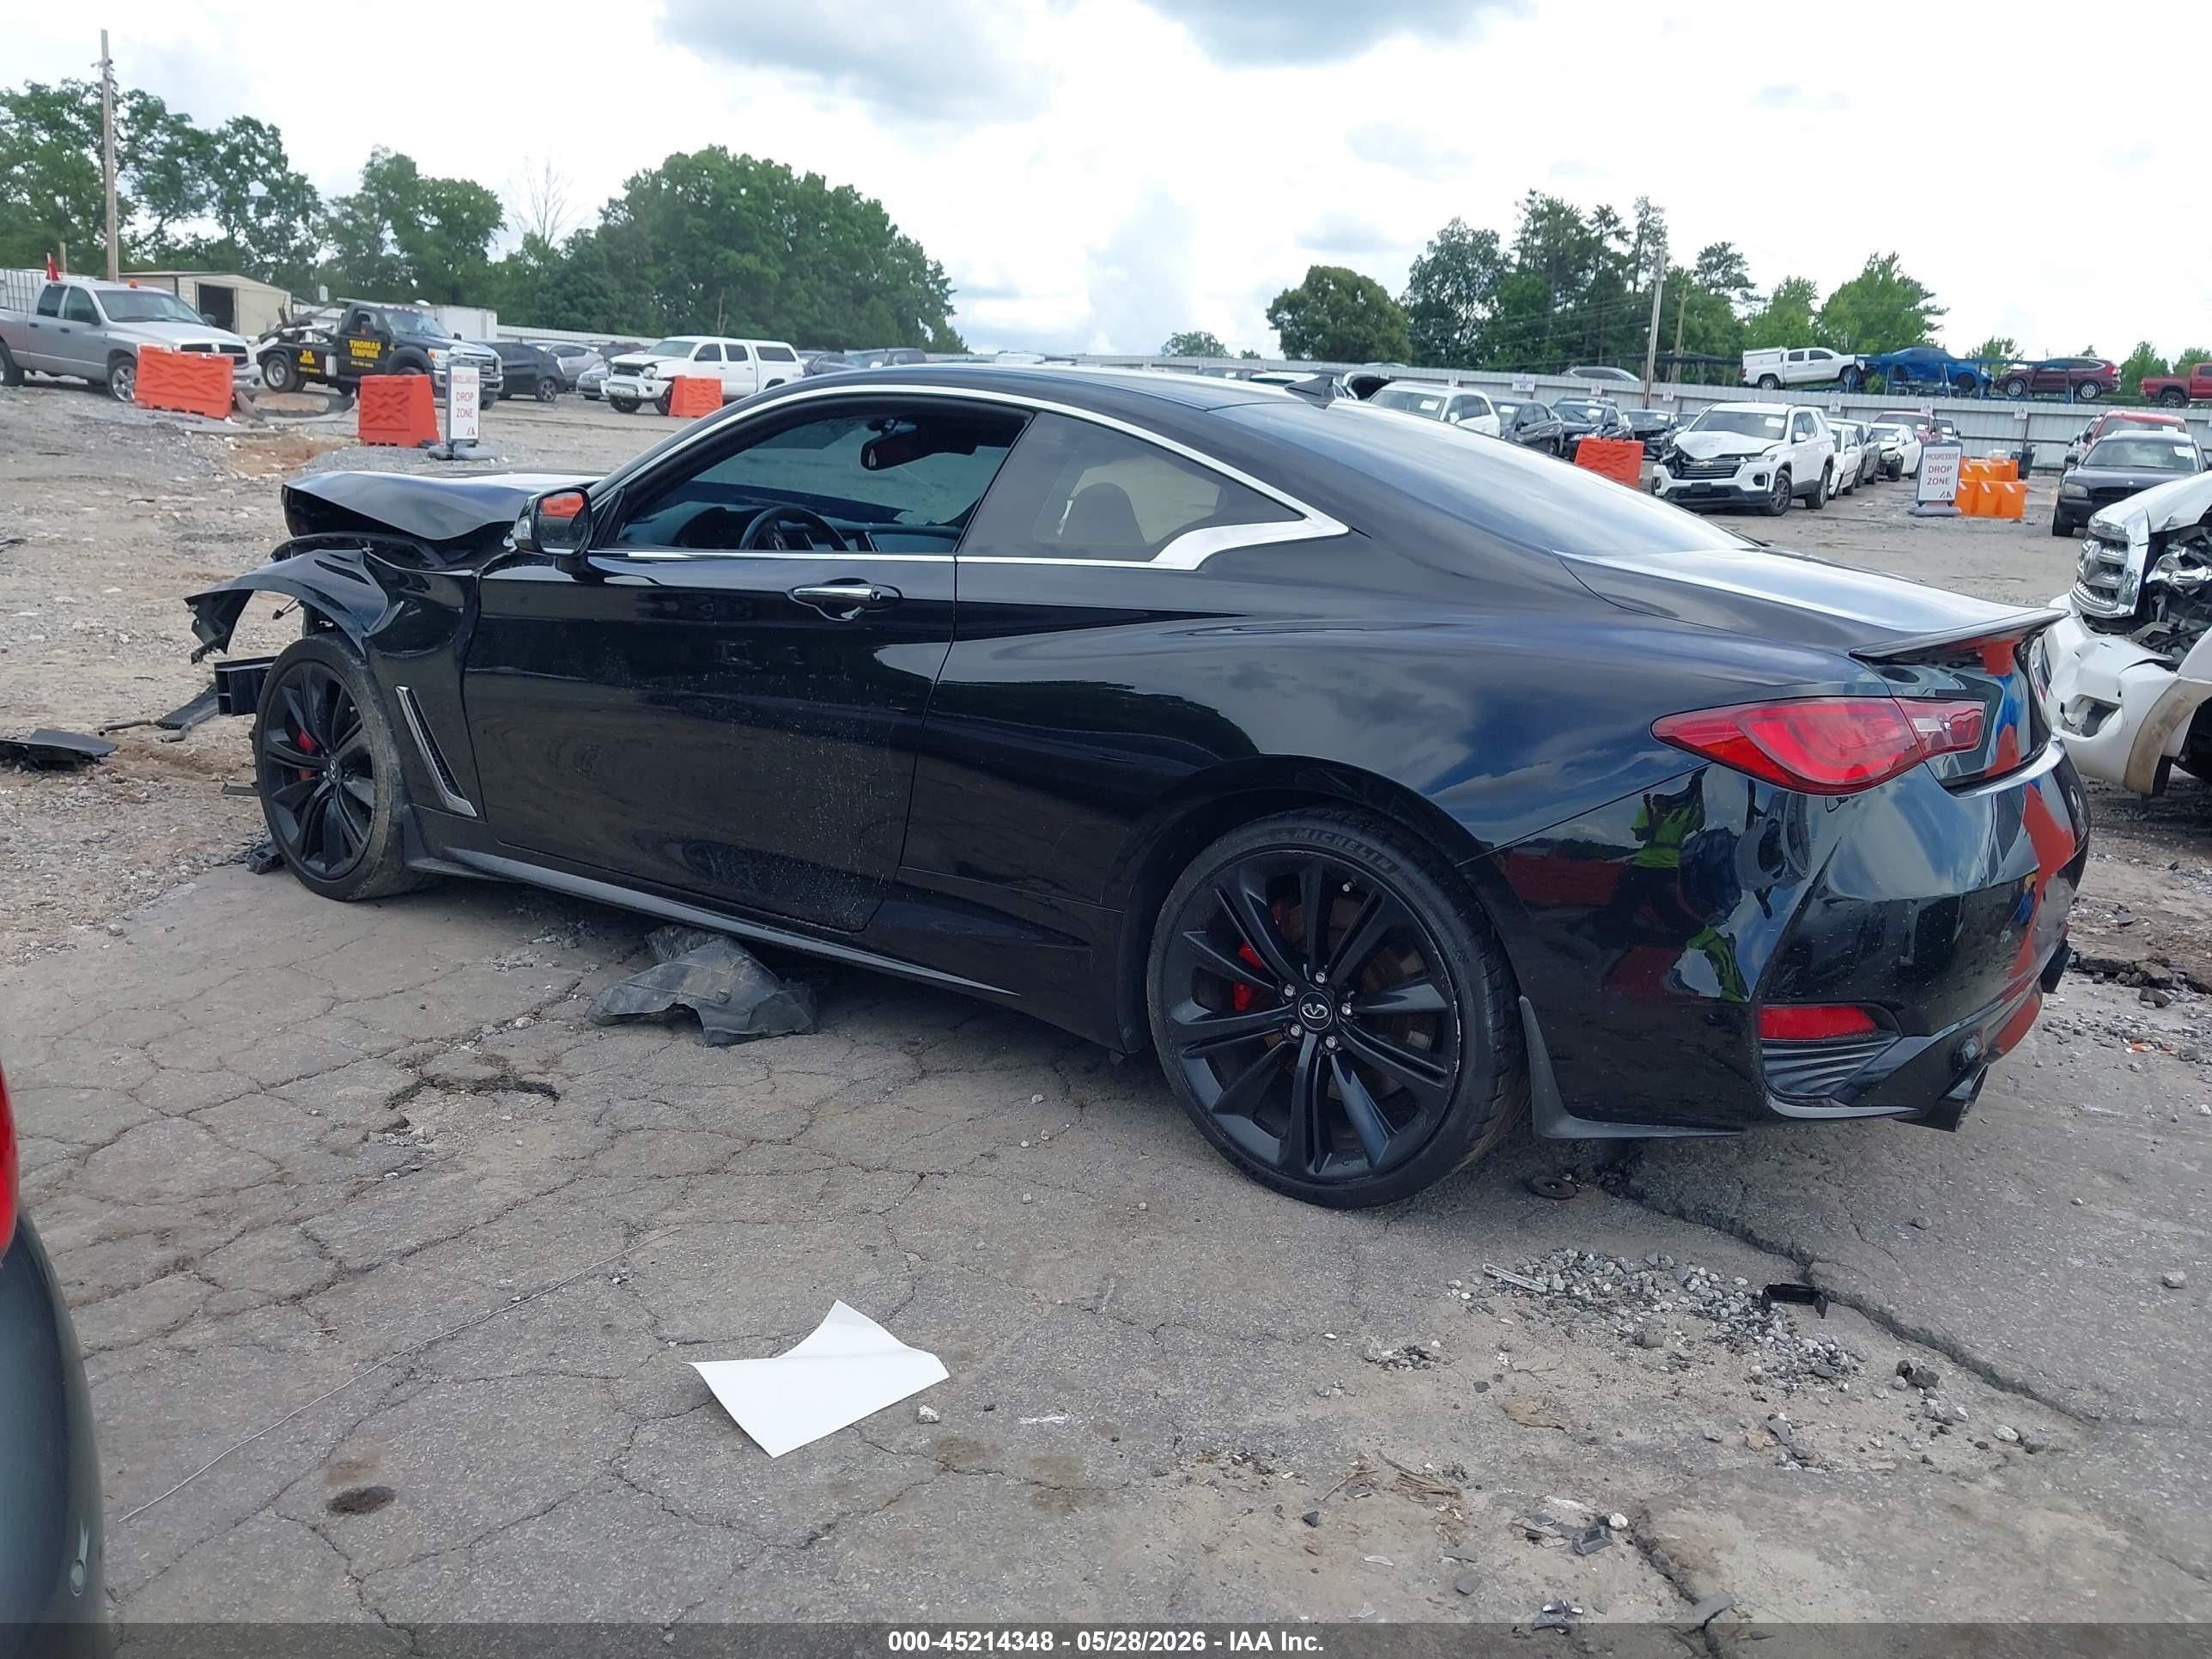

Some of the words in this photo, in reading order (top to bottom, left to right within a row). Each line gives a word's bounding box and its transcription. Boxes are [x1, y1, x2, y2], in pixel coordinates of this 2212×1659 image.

[349, 339, 381, 351] THOMAS
[456, 392, 474, 402] DROP
[457, 408, 474, 418] ZONE
[1925, 453, 1959, 461] PROGRESSIVE
[1929, 465, 1952, 474] DROP
[1295, 830, 1394, 869] MICHELIN
